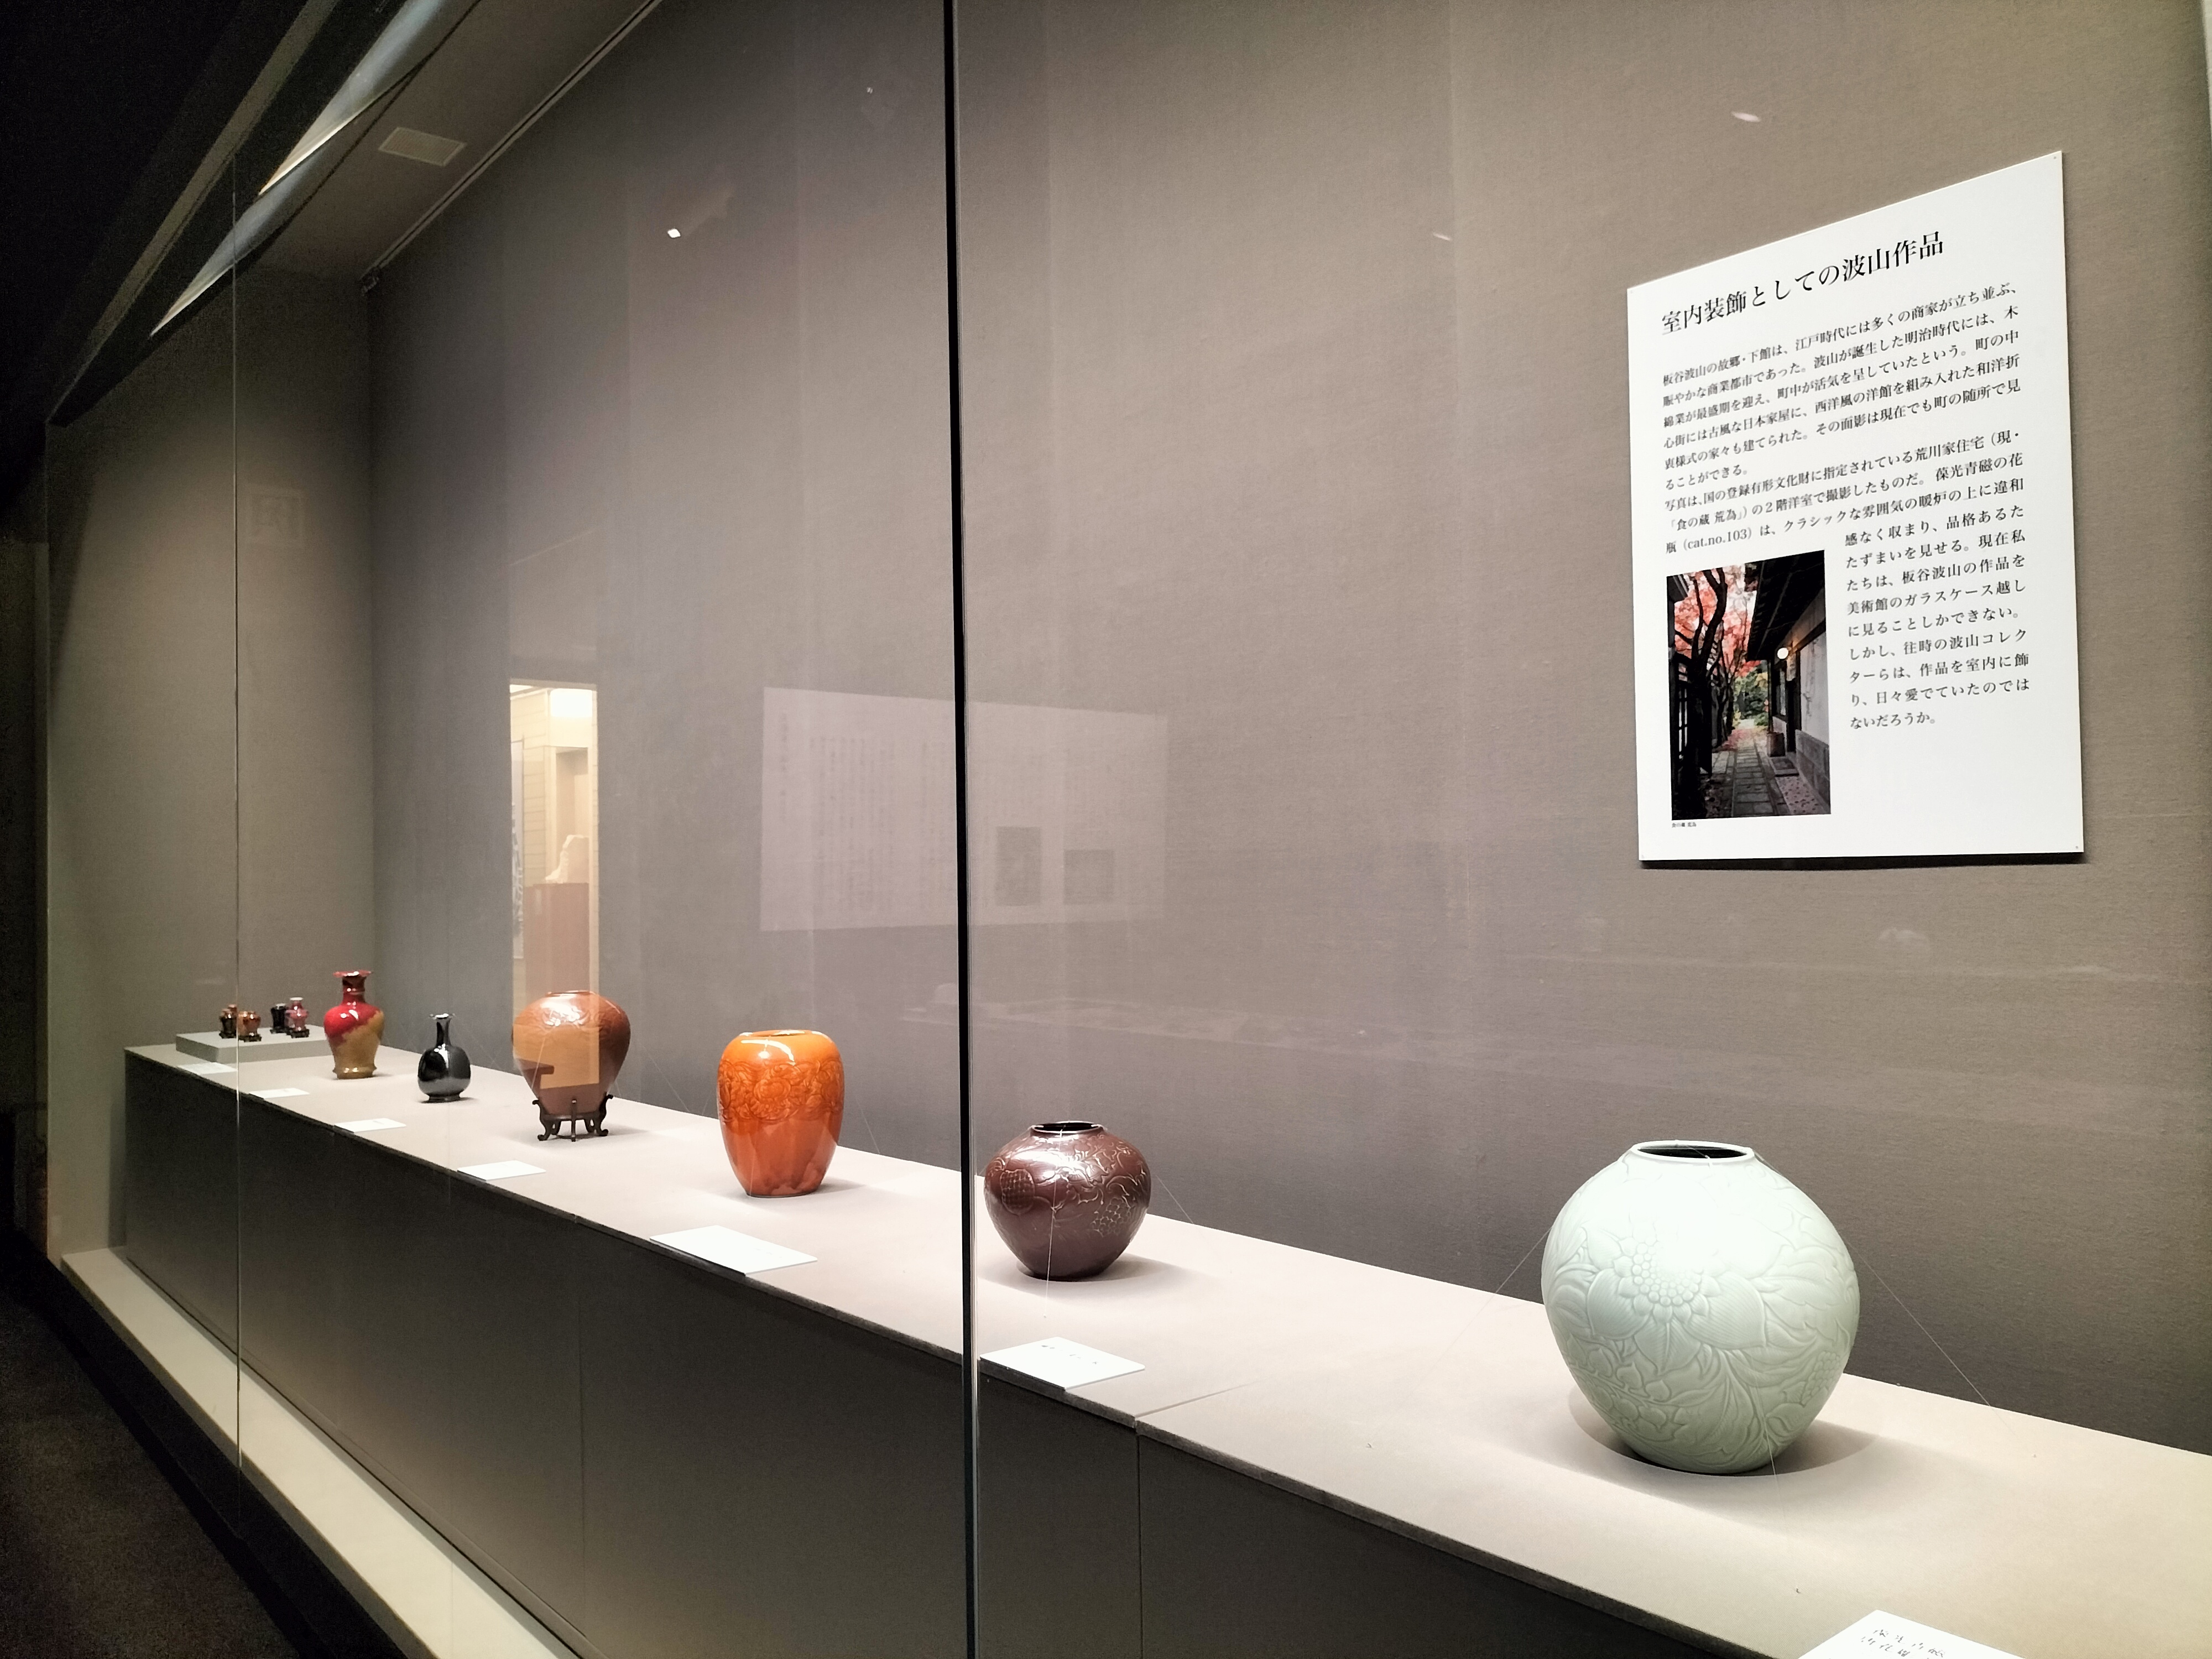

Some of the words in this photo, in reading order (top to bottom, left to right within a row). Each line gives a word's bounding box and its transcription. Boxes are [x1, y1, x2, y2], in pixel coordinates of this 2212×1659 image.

[1662, 231, 1943, 335] 室内装飾としての波山作品
[1666, 465, 1747, 491] ることができる。
[1845, 505, 2024, 546] 感なく収まり、品格あるた
[1846, 529, 2026, 568] たずまいを見せる。現在私
[1847, 554, 2026, 591] たちは、板谷波山の作品を
[1848, 580, 2026, 615] 美術館のガラスケース越し
[1848, 607, 2018, 637] に見ることしかできない。
[1850, 629, 2026, 660] しかし、往時の波山コレク
[1850, 653, 2029, 684] ターらは、作品を室内に飾
[1851, 678, 2030, 707] り、日々愛でていたのでは
[1850, 712, 1936, 729] ないだろうか。
